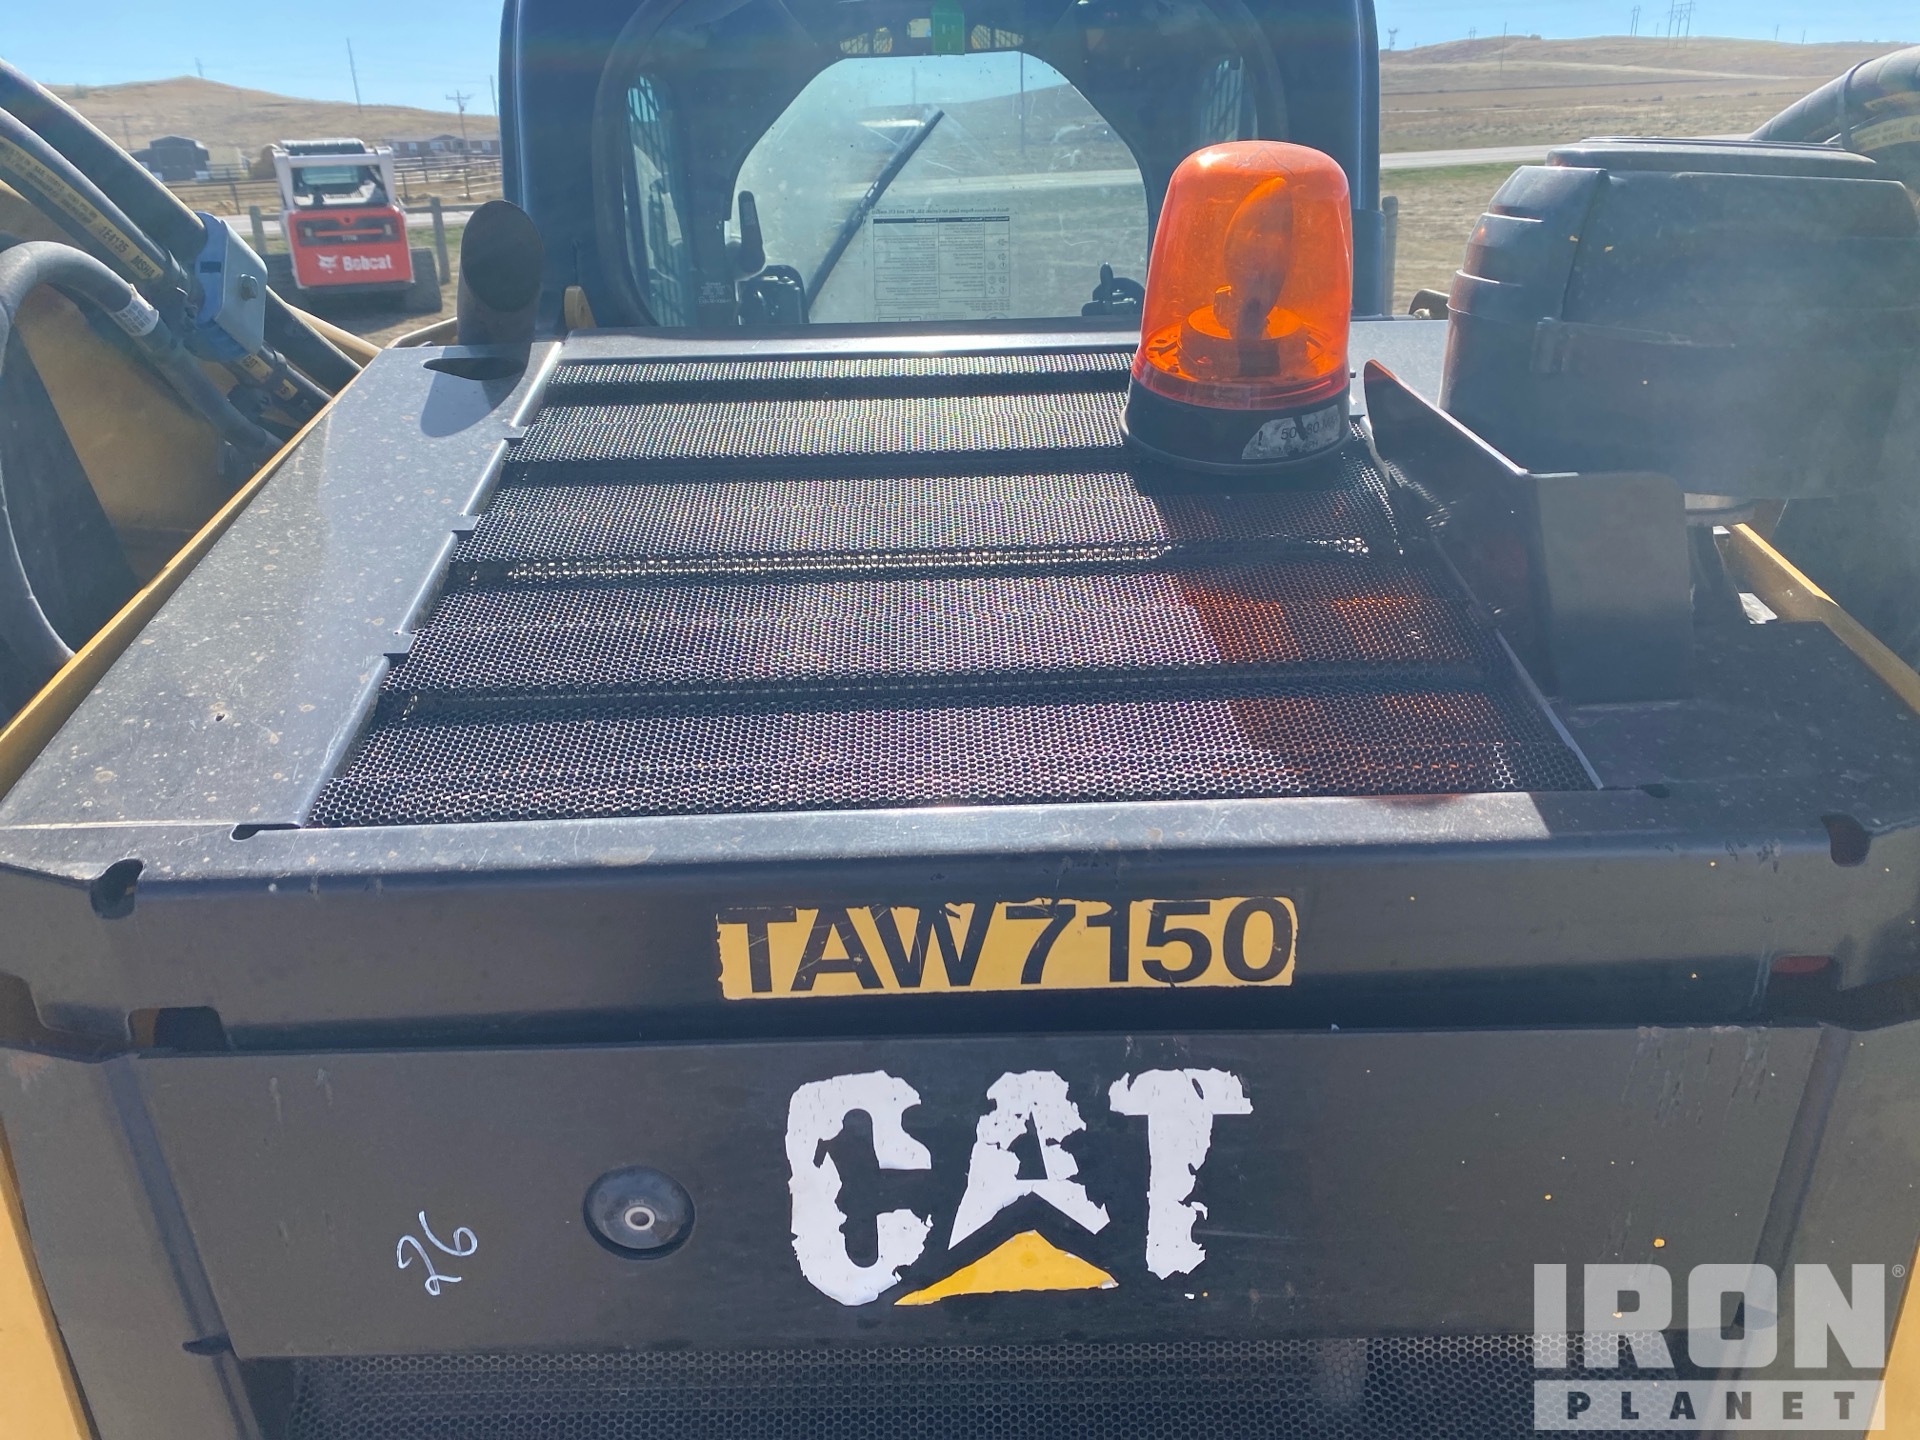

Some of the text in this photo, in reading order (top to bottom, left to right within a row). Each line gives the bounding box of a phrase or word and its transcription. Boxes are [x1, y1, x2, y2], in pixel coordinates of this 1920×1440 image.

[342, 255, 392, 271] Bobcat
[717, 897, 1293, 993] TAW7150
[786, 1068, 1254, 1306] CAT
[396, 1210, 478, 1296] 26
